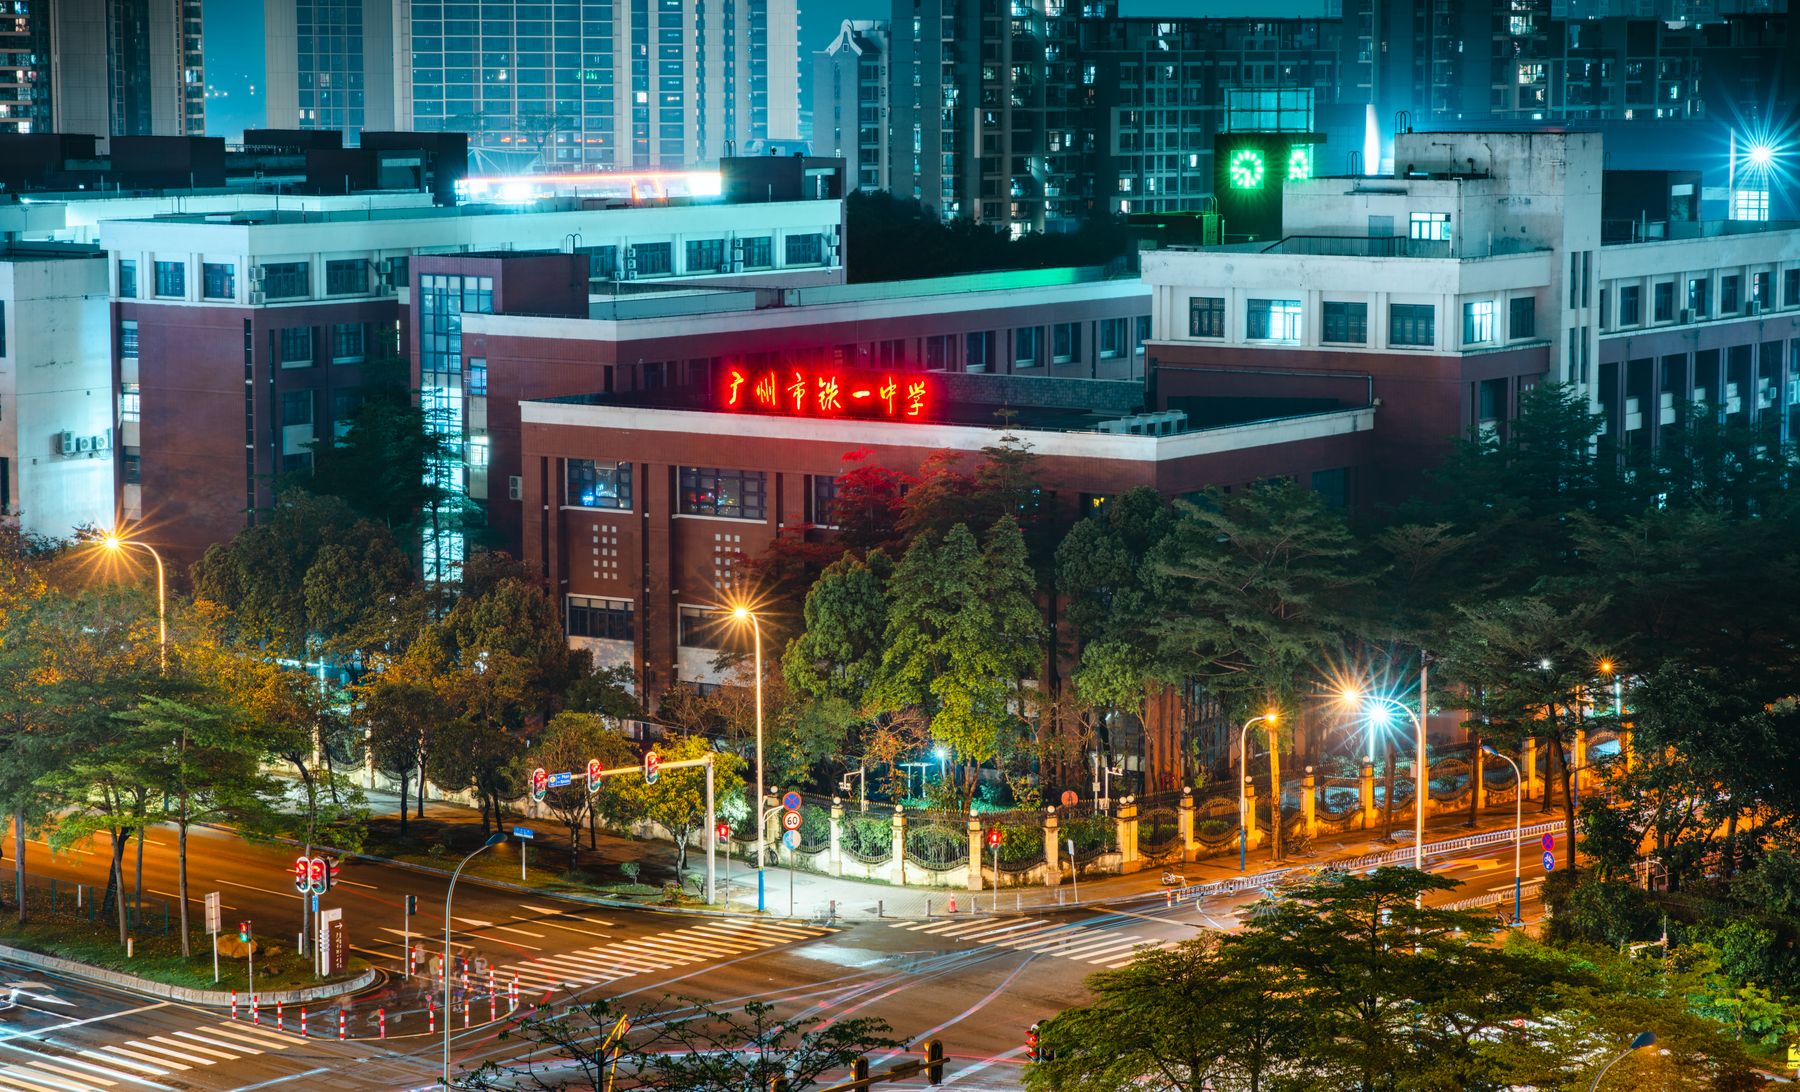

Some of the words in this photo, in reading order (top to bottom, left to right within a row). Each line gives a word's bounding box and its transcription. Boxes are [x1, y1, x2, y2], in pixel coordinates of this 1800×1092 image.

[728, 371, 926, 416] 广州市铁一中学
[786, 816, 798, 826] 60
